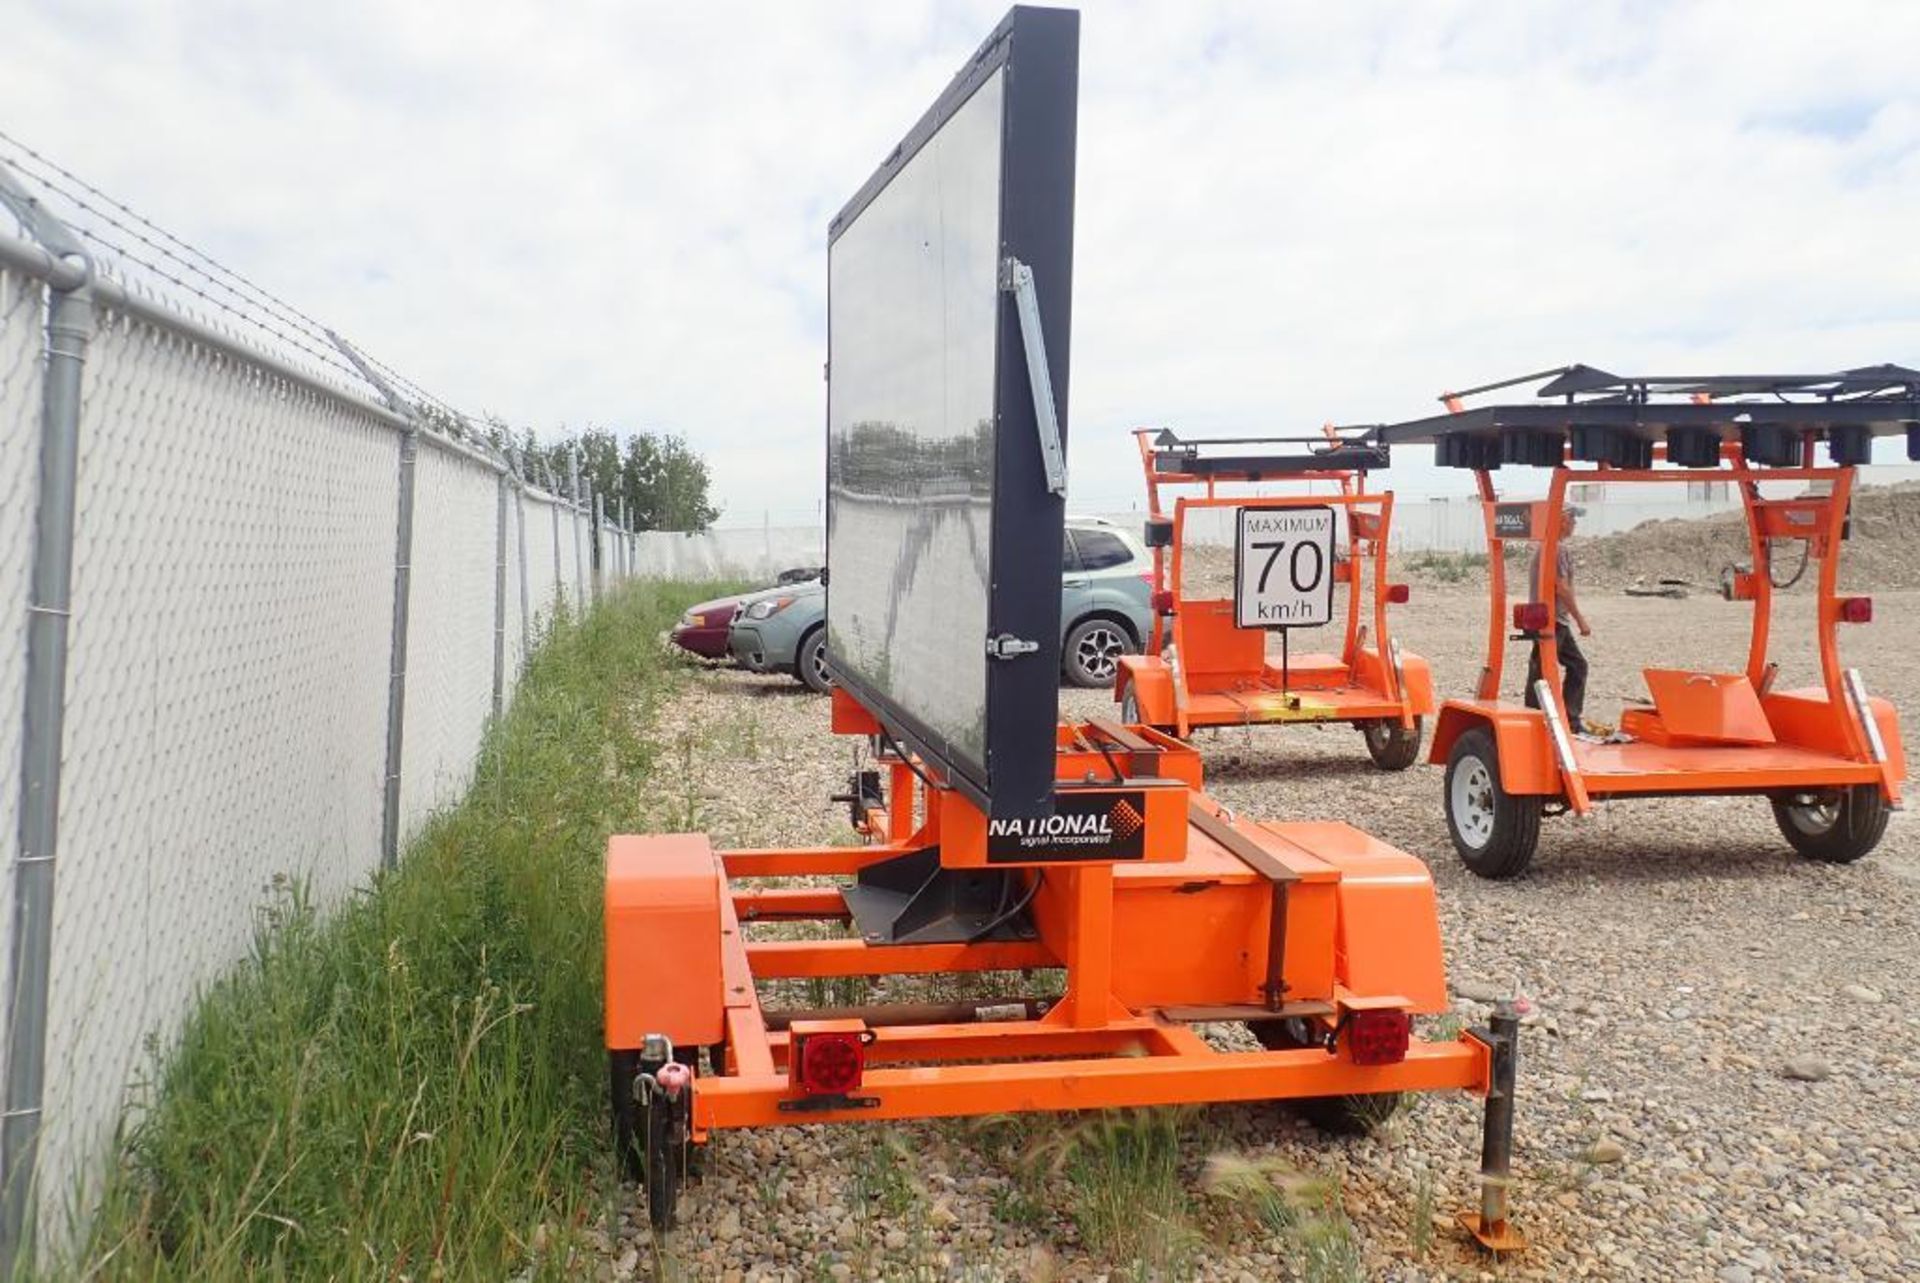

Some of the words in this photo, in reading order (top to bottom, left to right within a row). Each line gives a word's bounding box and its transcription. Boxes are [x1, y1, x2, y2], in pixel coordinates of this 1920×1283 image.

[1247, 518, 1328, 533] MAXIMUM
[1251, 541, 1323, 594] 70
[1258, 601, 1312, 618] km/h
[1020, 835, 1049, 847] signal
[1051, 834, 1111, 845] incorporated
